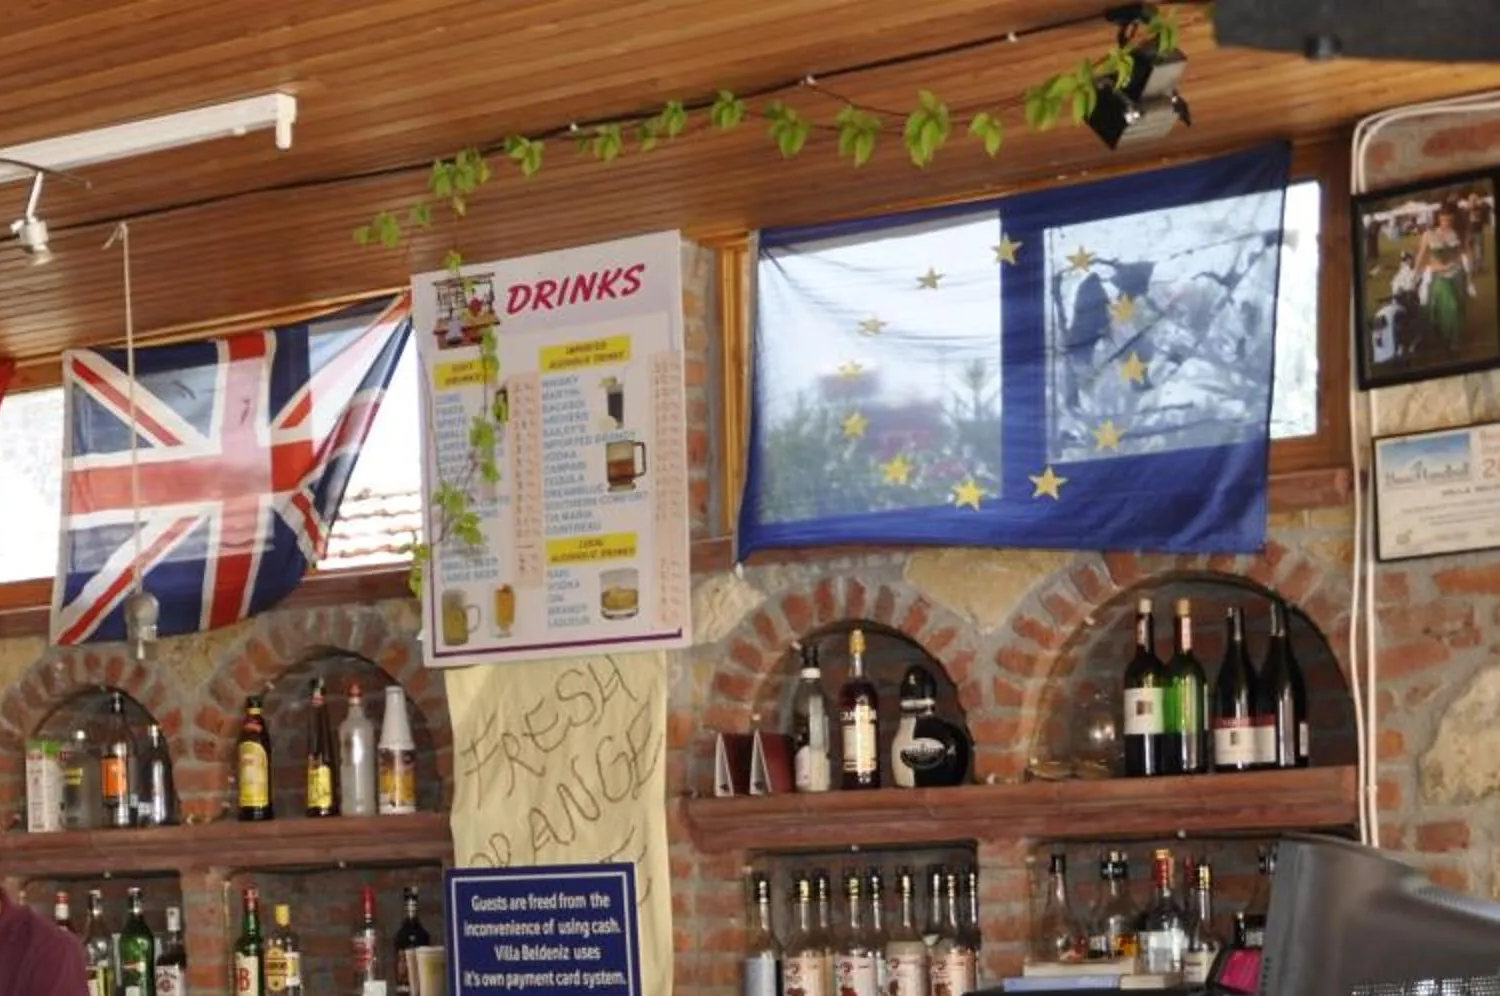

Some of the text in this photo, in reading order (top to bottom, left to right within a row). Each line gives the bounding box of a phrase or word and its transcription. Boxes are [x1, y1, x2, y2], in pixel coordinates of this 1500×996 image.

[507, 263, 645, 315] DRINKS
[460, 654, 638, 810] FRESH
[471, 891, 611, 912] Guests are freed from the
[542, 918, 555, 934] of
[558, 920, 590, 938] using
[494, 944, 520, 961] Villa
[573, 946, 602, 960] uses
[482, 973, 505, 987] own
[506, 973, 554, 989] payment
[555, 969, 581, 986] card
